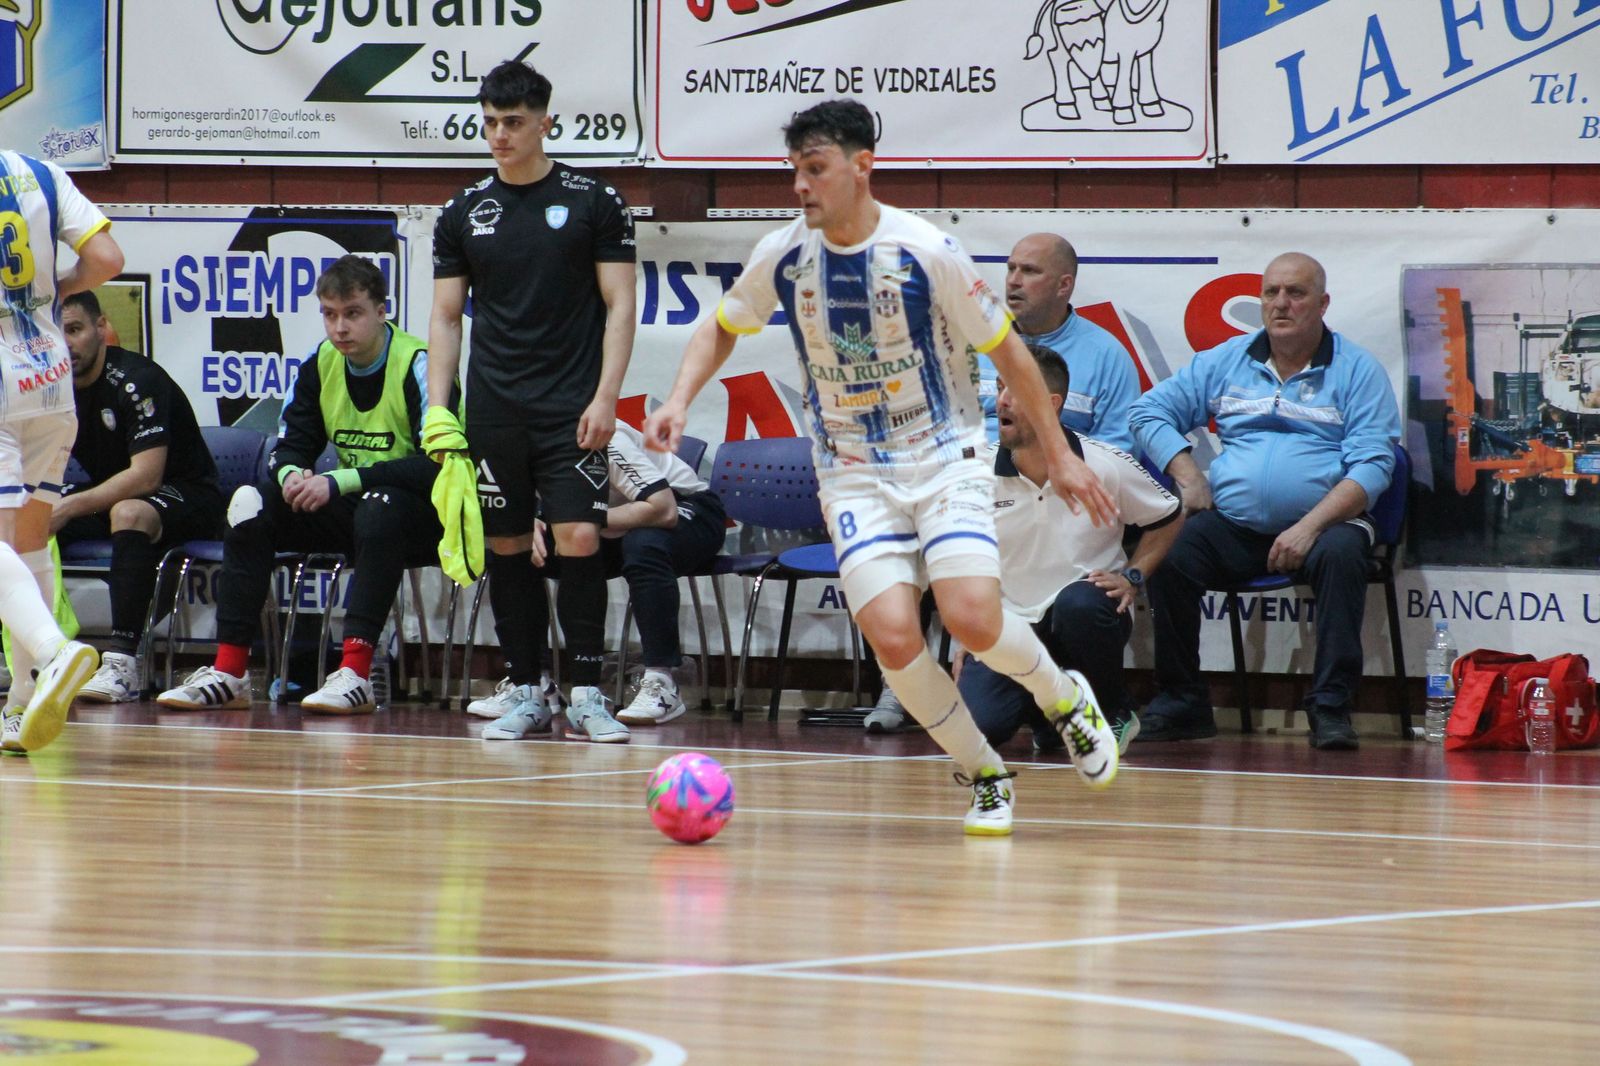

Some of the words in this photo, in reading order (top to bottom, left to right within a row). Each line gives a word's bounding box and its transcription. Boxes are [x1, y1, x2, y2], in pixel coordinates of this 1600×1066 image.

[684, 61, 825, 94] SANTIBAÑEZ
[835, 66, 864, 94] DE
[874, 65, 997, 94] VIDRIALES
[1275, 13, 1411, 151] LA
[1529, 73, 1588, 105] Tel.
[132, 107, 336, 123] hormigonesgerardin2017@outlook.es
[400, 120, 438, 139] Telf.:
[574, 112, 627, 142] 289
[148, 126, 321, 141] gerardo-gejoman@hotmail.com
[468, 206, 503, 218] NISSAN
[471, 226, 496, 236] JAKO
[18, 357, 71, 394] MACIAS
[809, 363, 848, 383] CAJA
[853, 352, 922, 380] RURAL
[833, 389, 890, 408] ZAMORA
[838, 510, 858, 540] 8
[1406, 588, 1566, 624] BANCADA
